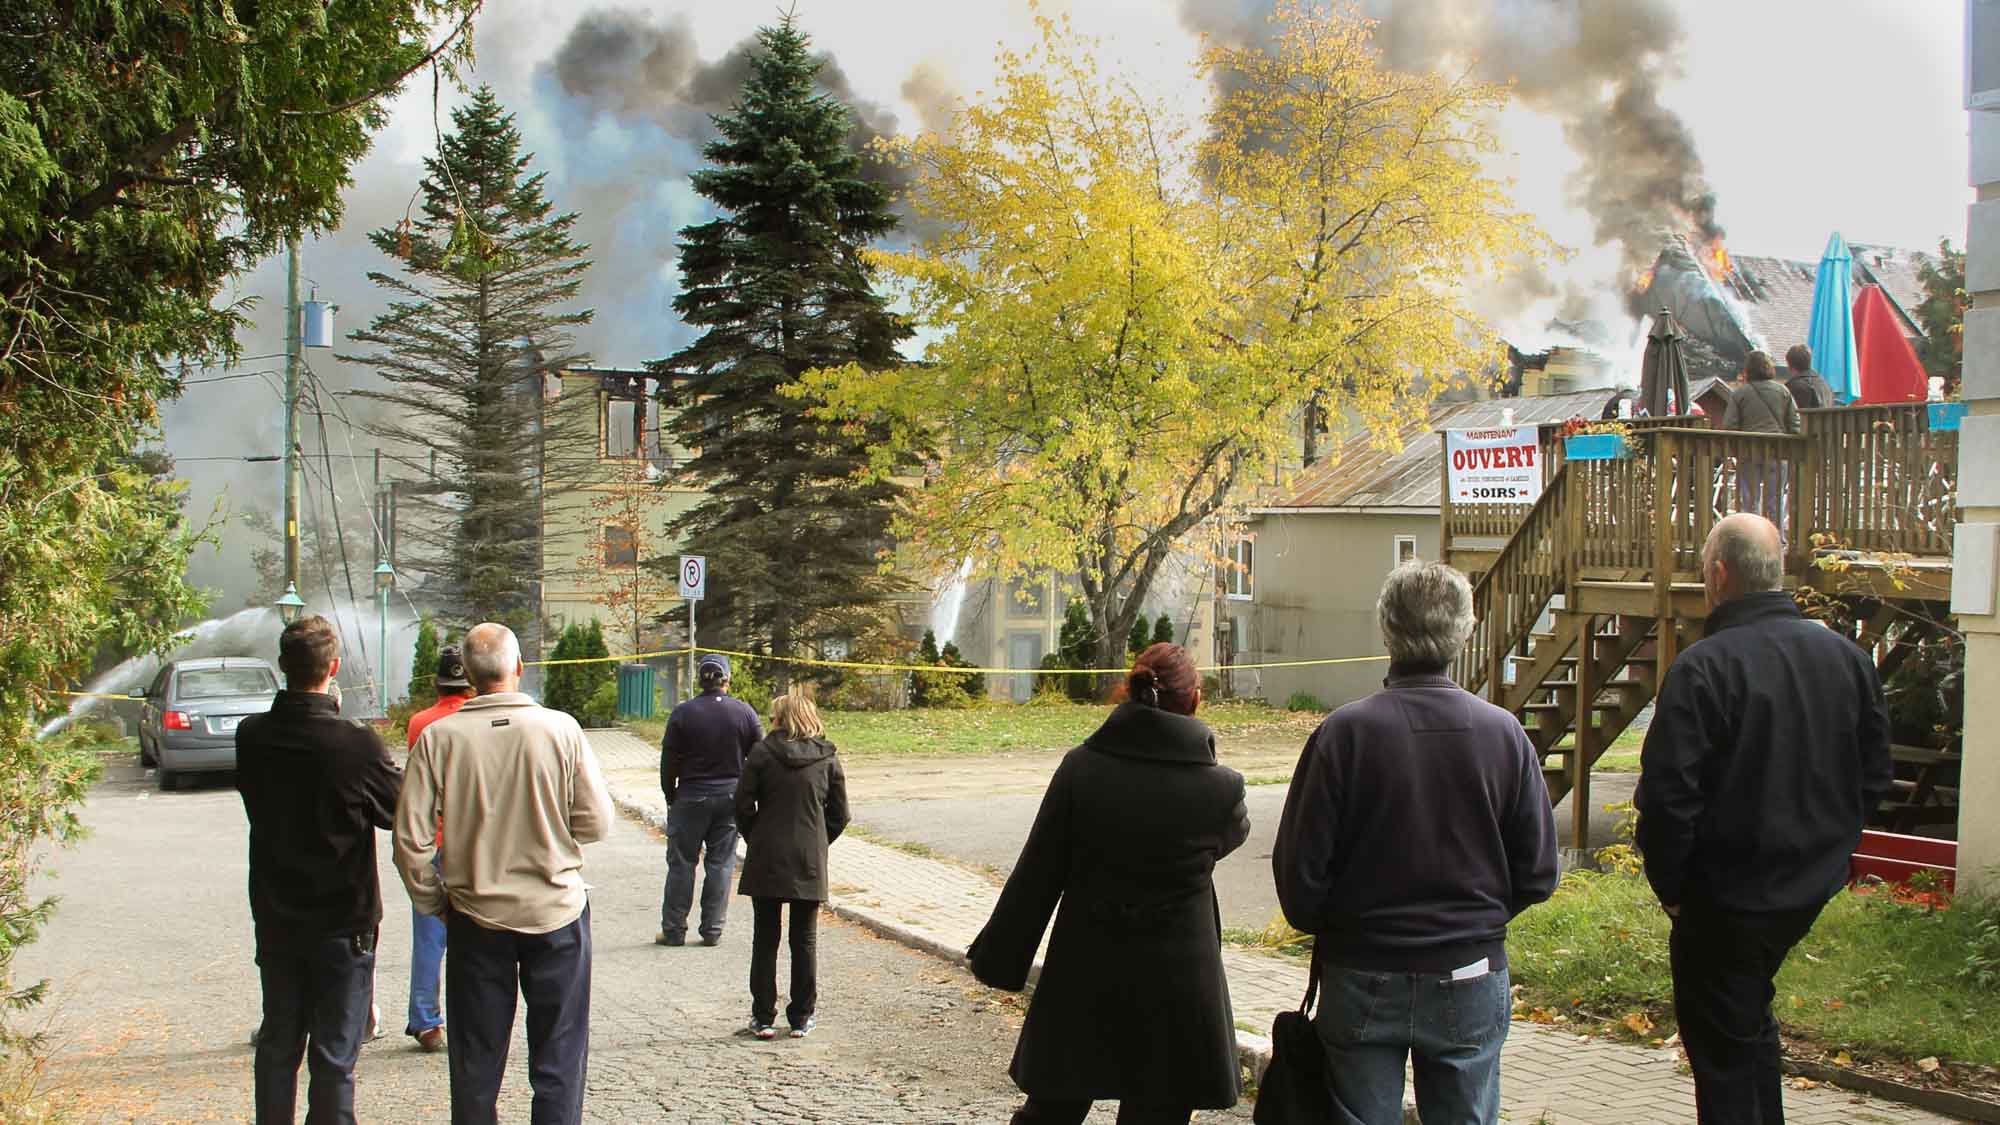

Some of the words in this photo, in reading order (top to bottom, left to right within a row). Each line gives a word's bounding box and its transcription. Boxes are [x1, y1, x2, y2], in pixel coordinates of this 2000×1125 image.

[1466, 429, 1517, 440] MAINTENANT
[1453, 445, 1536, 470] OUVERT
[1472, 487, 1516, 498] SOIRS
